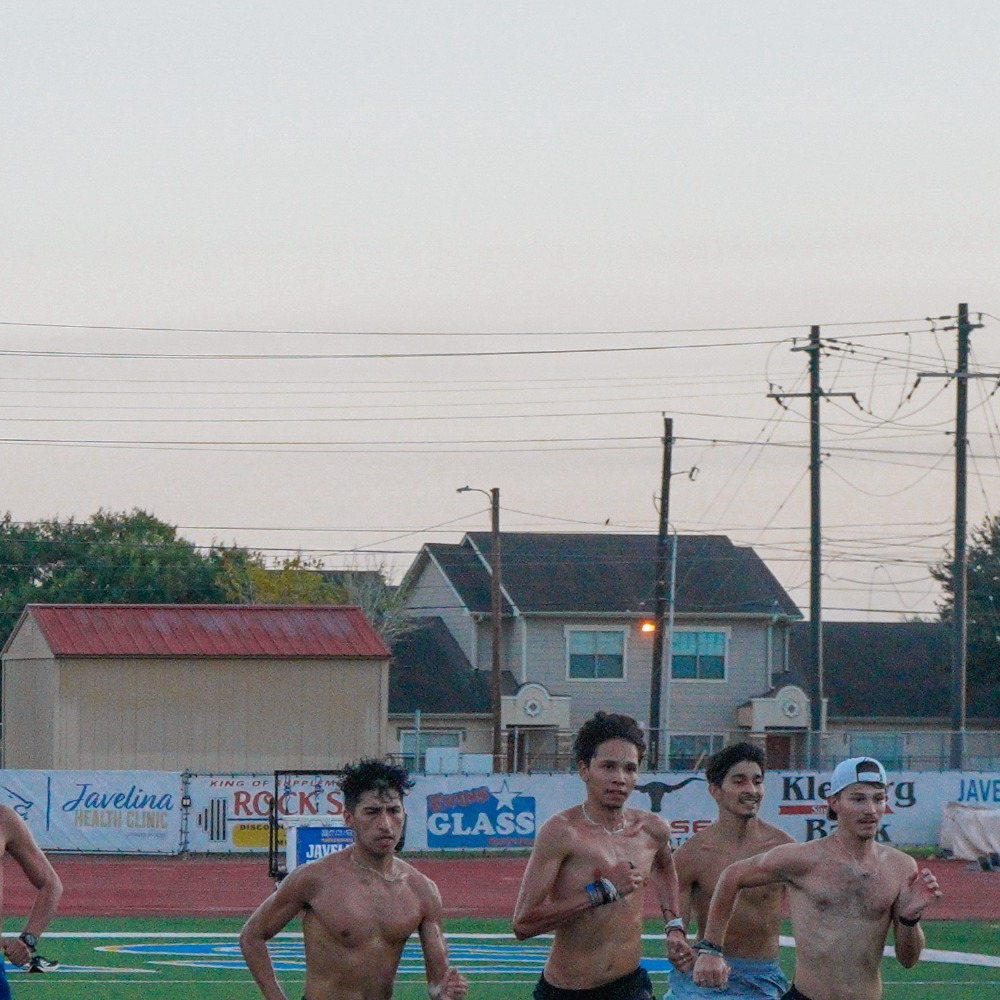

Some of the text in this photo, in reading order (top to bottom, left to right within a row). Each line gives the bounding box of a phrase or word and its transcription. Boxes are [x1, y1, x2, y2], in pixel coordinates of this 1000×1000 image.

[62, 783, 174, 812] Javelina
[234, 790, 318, 816] ROCK
[74, 810, 168, 829] HEALTH CLINIC
[427, 812, 535, 836] GLASS
